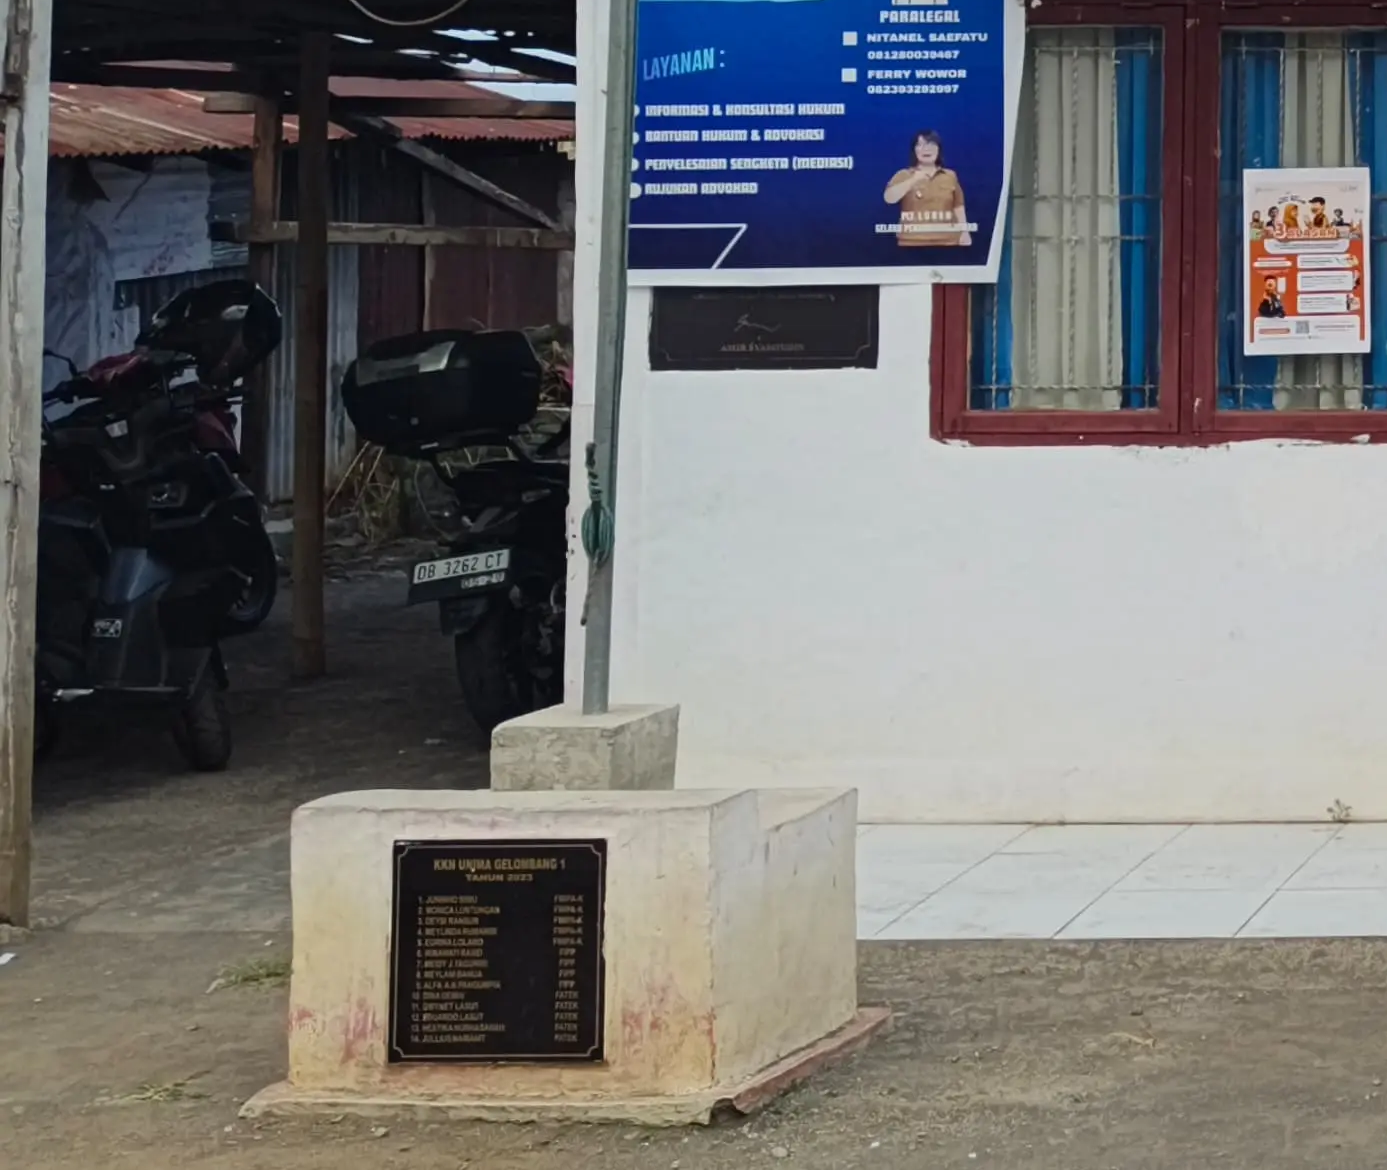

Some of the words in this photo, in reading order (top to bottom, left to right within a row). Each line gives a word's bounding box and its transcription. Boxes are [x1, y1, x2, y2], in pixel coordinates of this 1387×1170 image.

[879, 10, 960, 23] PARALEGAL
[866, 33, 925, 43] NITANEL
[643, 47, 716, 81] LAYANAN
[867, 69, 912, 79] FERRY
[915, 69, 967, 79] WOWOR
[645, 104, 709, 117] INFORMASI
[712, 104, 723, 116] &
[725, 103, 795, 116] KONSULTASI
[798, 103, 845, 116] HUKUM
[645, 130, 699, 142] BANTUAN
[701, 129, 748, 142] HUKUM
[751, 129, 761, 141] &
[764, 128, 825, 141] ADVOKASI
[730, 157, 789, 170] SENGKETA
[792, 156, 854, 171] (MEDIASI)
[417, 564, 436, 580] DB
[443, 556, 479, 576] 3262
[485, 552, 503, 569] CT
[433, 859, 456, 871] KKN
[494, 858, 557, 870] GELOMBANG
[560, 858, 566, 869] 1
[466, 873, 504, 882] TAHUN
